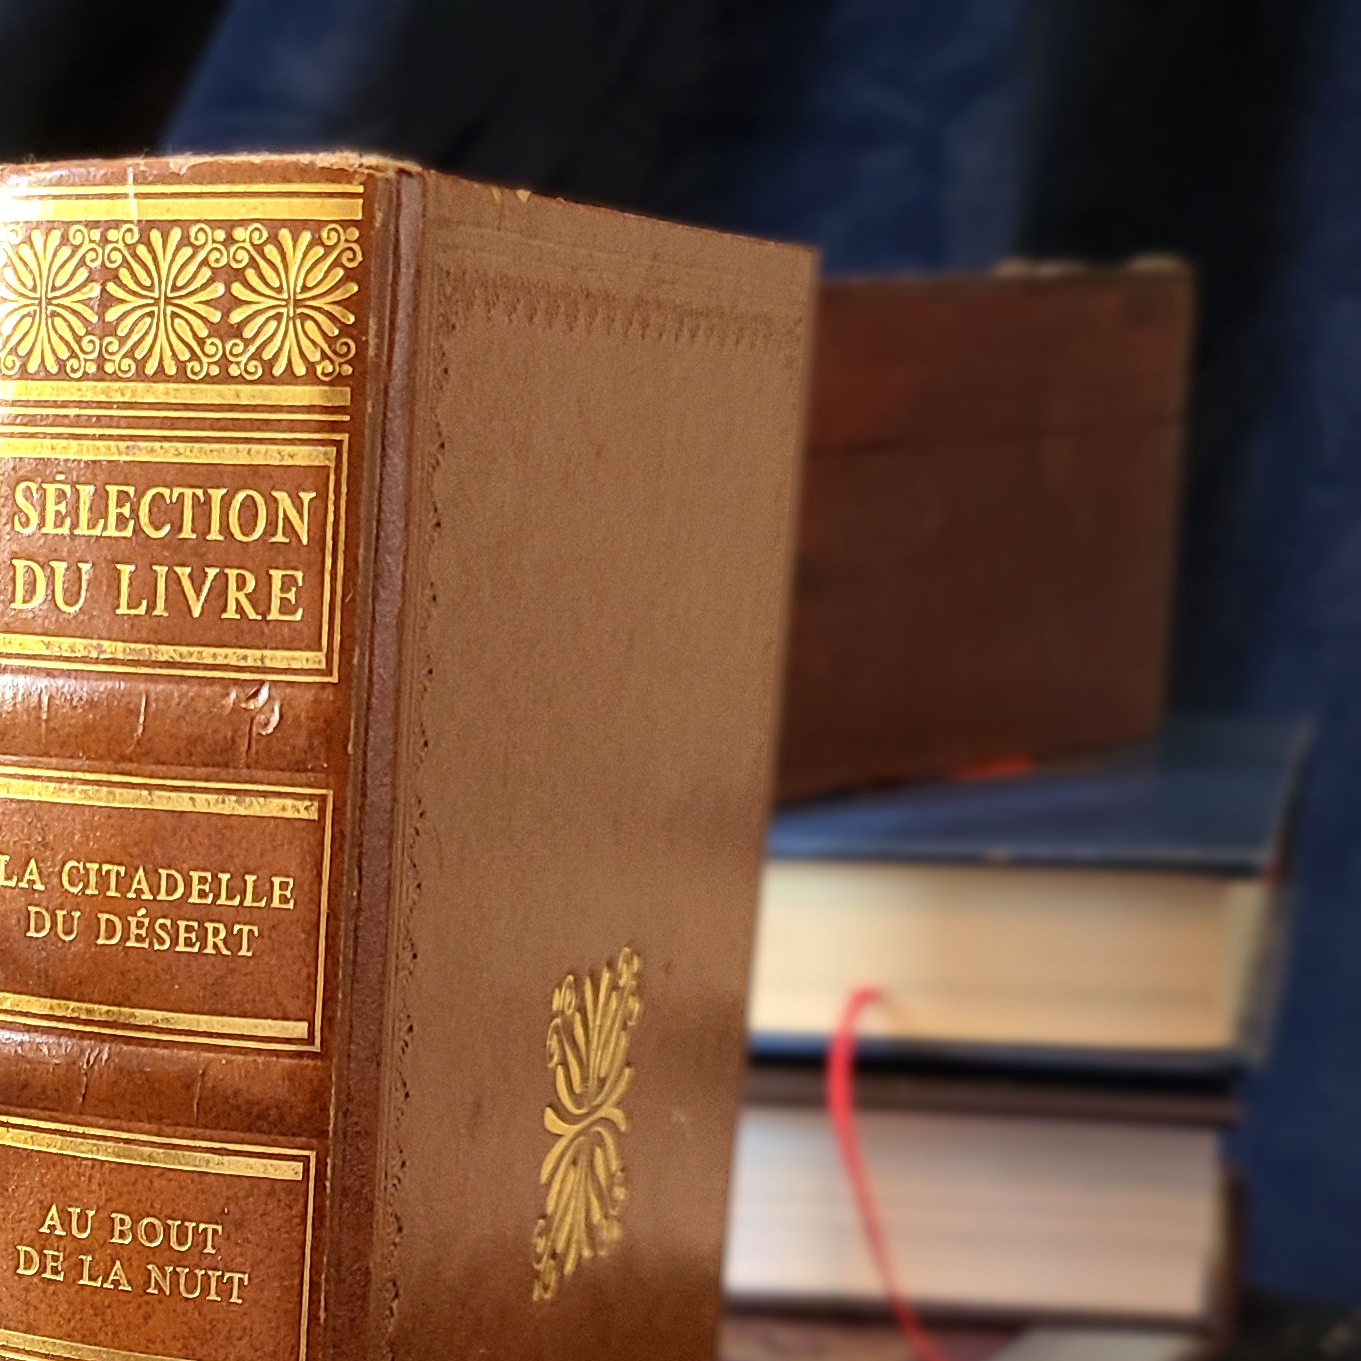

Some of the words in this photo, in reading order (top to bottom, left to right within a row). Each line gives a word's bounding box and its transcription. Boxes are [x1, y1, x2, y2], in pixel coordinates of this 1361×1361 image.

[13, 473, 317, 546] SÉLECTION
[11, 558, 93, 613] DU
[115, 563, 304, 622] LIVRE
[61, 859, 296, 910] CITADELLE
[25, 905, 81, 941] DU
[96, 907, 259, 957] DÉSERT
[39, 1203, 96, 1239] AU
[109, 1212, 223, 1255] BOUT
[15, 1245, 65, 1282] DE
[77, 1254, 132, 1292] LA
[146, 1263, 249, 1304] NUIT
